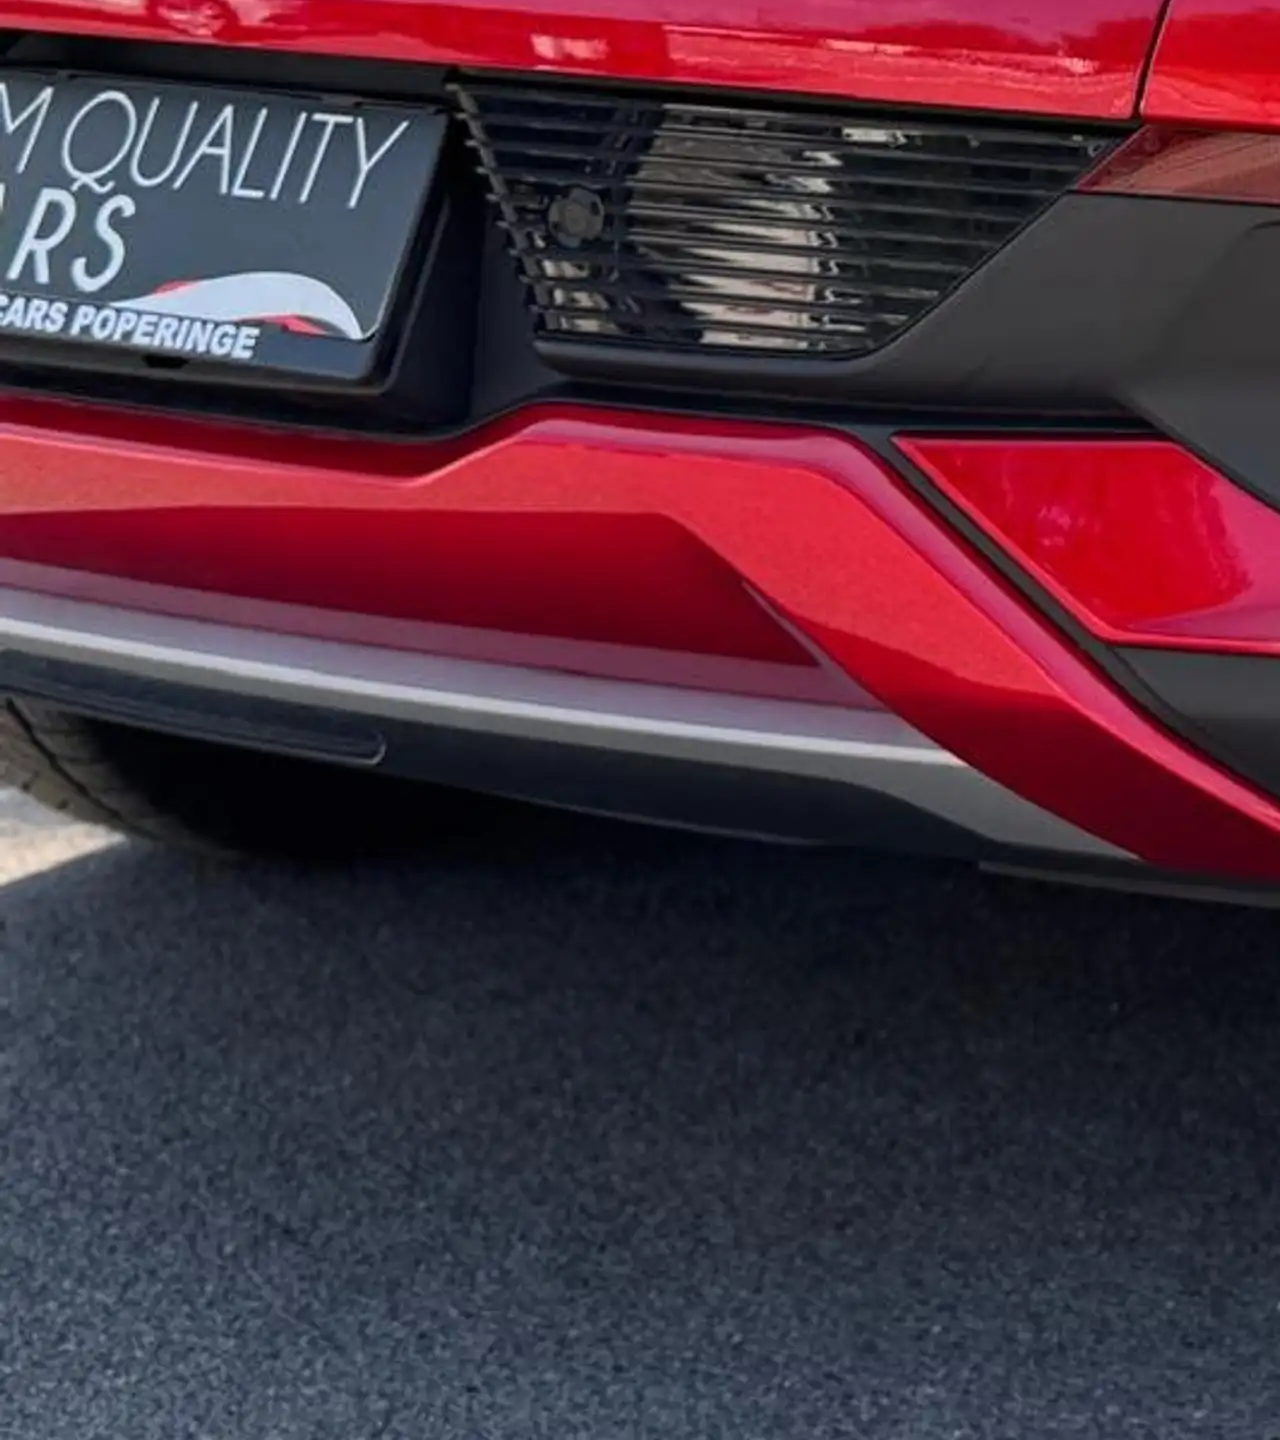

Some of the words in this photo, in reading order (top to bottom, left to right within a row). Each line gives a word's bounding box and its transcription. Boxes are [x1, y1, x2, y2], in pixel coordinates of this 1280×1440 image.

[61, 90, 410, 210] QUALITY
[0, 183, 136, 293] RS
[70, 304, 261, 360] POPERINGE
